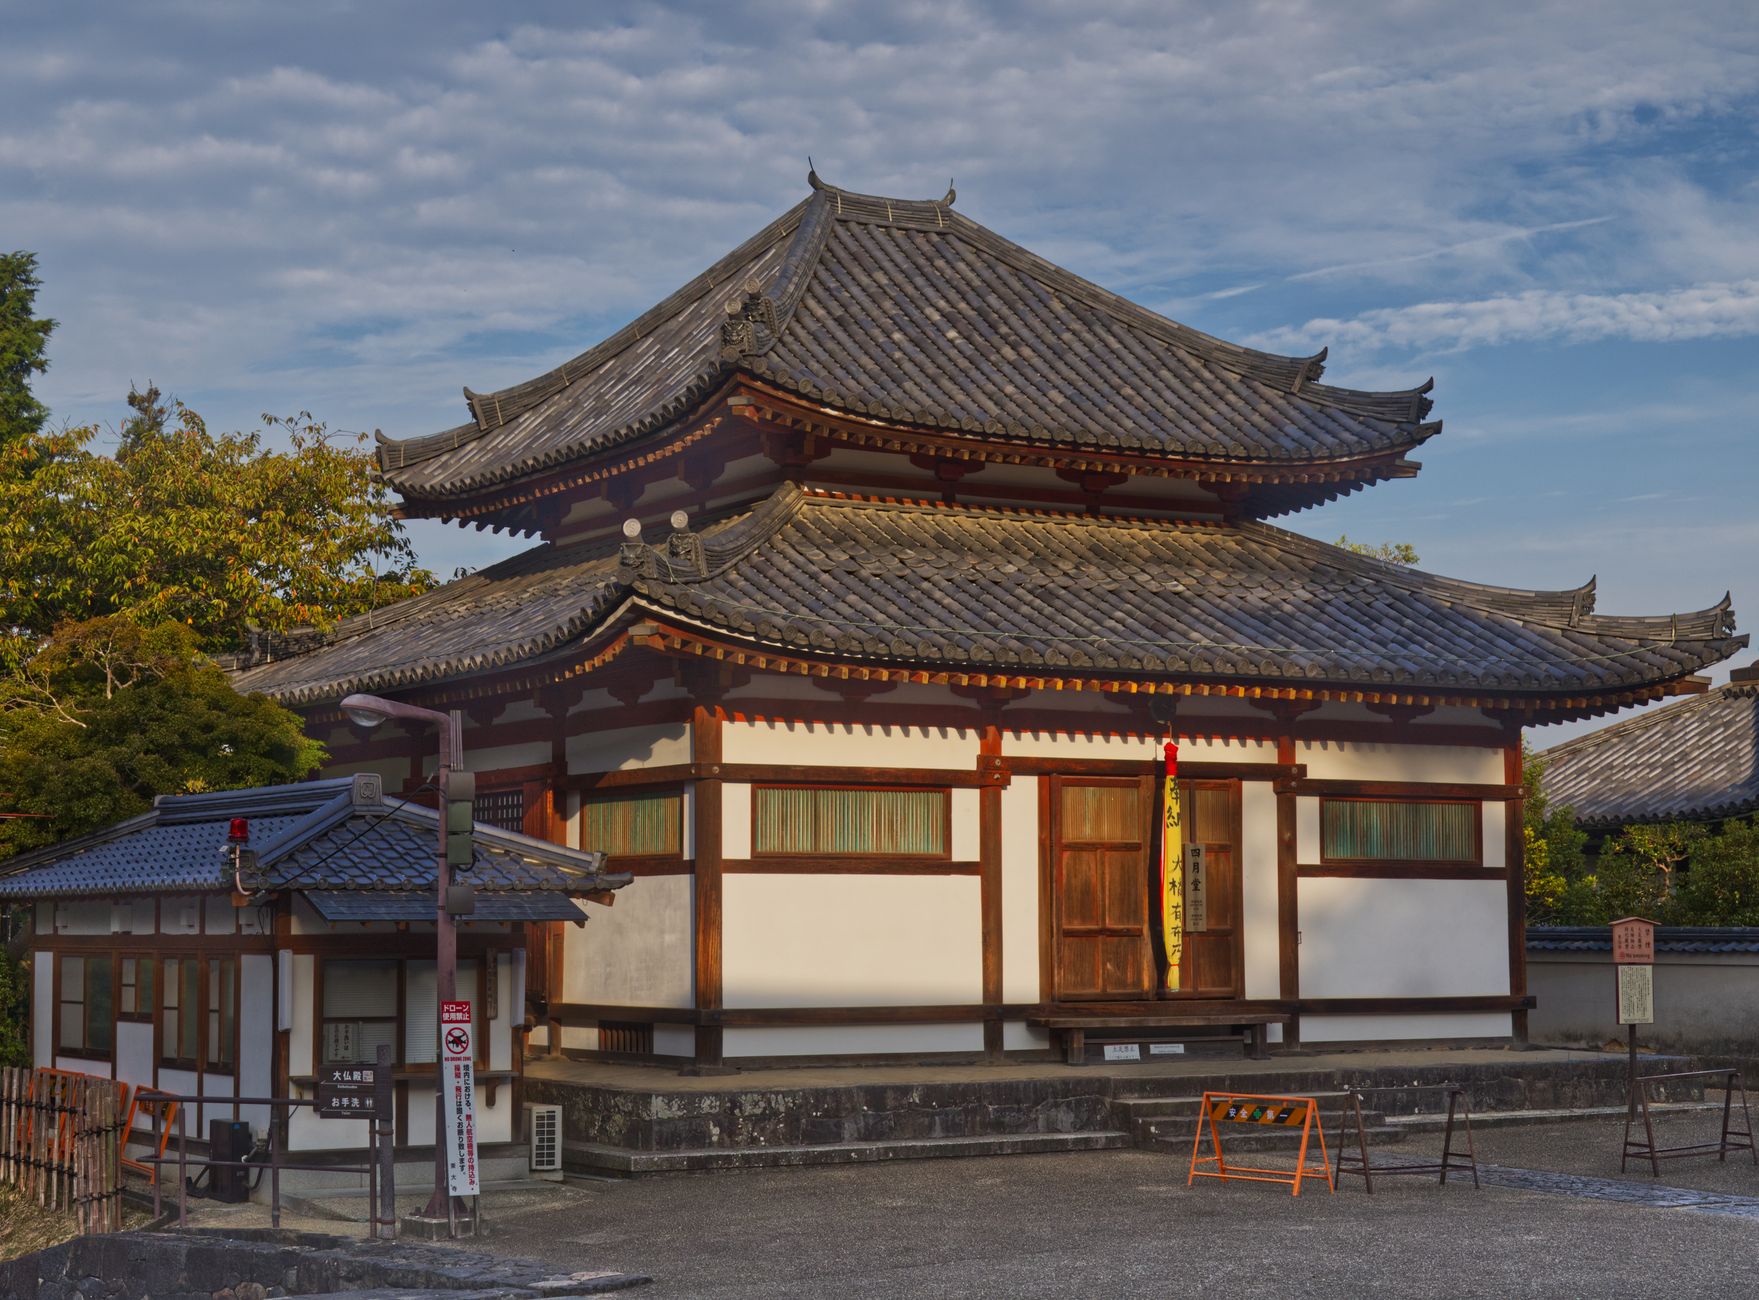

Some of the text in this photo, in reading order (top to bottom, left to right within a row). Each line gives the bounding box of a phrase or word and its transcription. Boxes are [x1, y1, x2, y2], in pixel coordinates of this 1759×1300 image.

[1190, 848, 1201, 892] 四月堂
[443, 1004, 469, 1012] ドローン
[442, 1012, 470, 1021] 使用禁止
[332, 1070, 362, 1081] 大仏殿
[331, 1097, 360, 1108] お手洗
